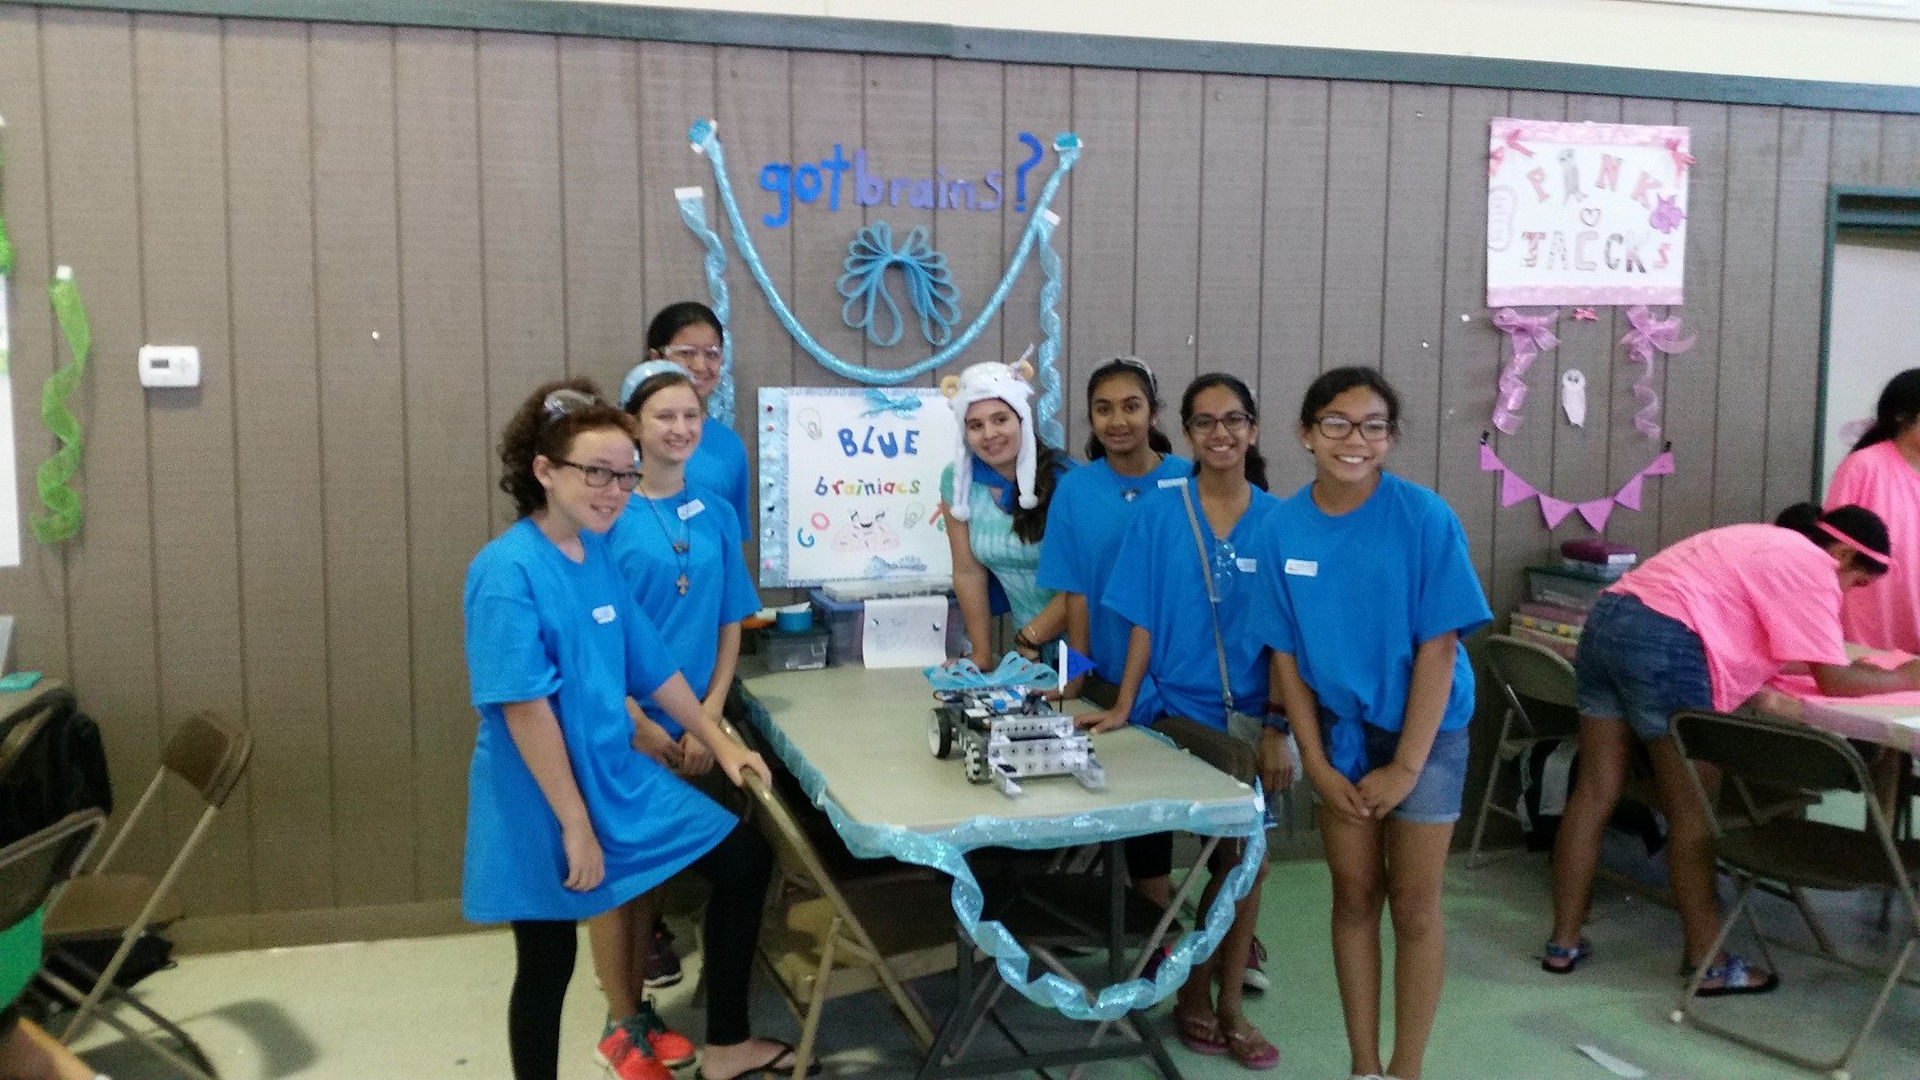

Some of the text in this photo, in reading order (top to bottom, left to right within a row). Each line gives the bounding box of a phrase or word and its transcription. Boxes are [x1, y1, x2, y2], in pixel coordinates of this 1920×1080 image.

[759, 143, 851, 228] got
[1526, 149, 1663, 210] PINK
[837, 425, 921, 458] BLUE
[815, 476, 921, 496] brainiacs
